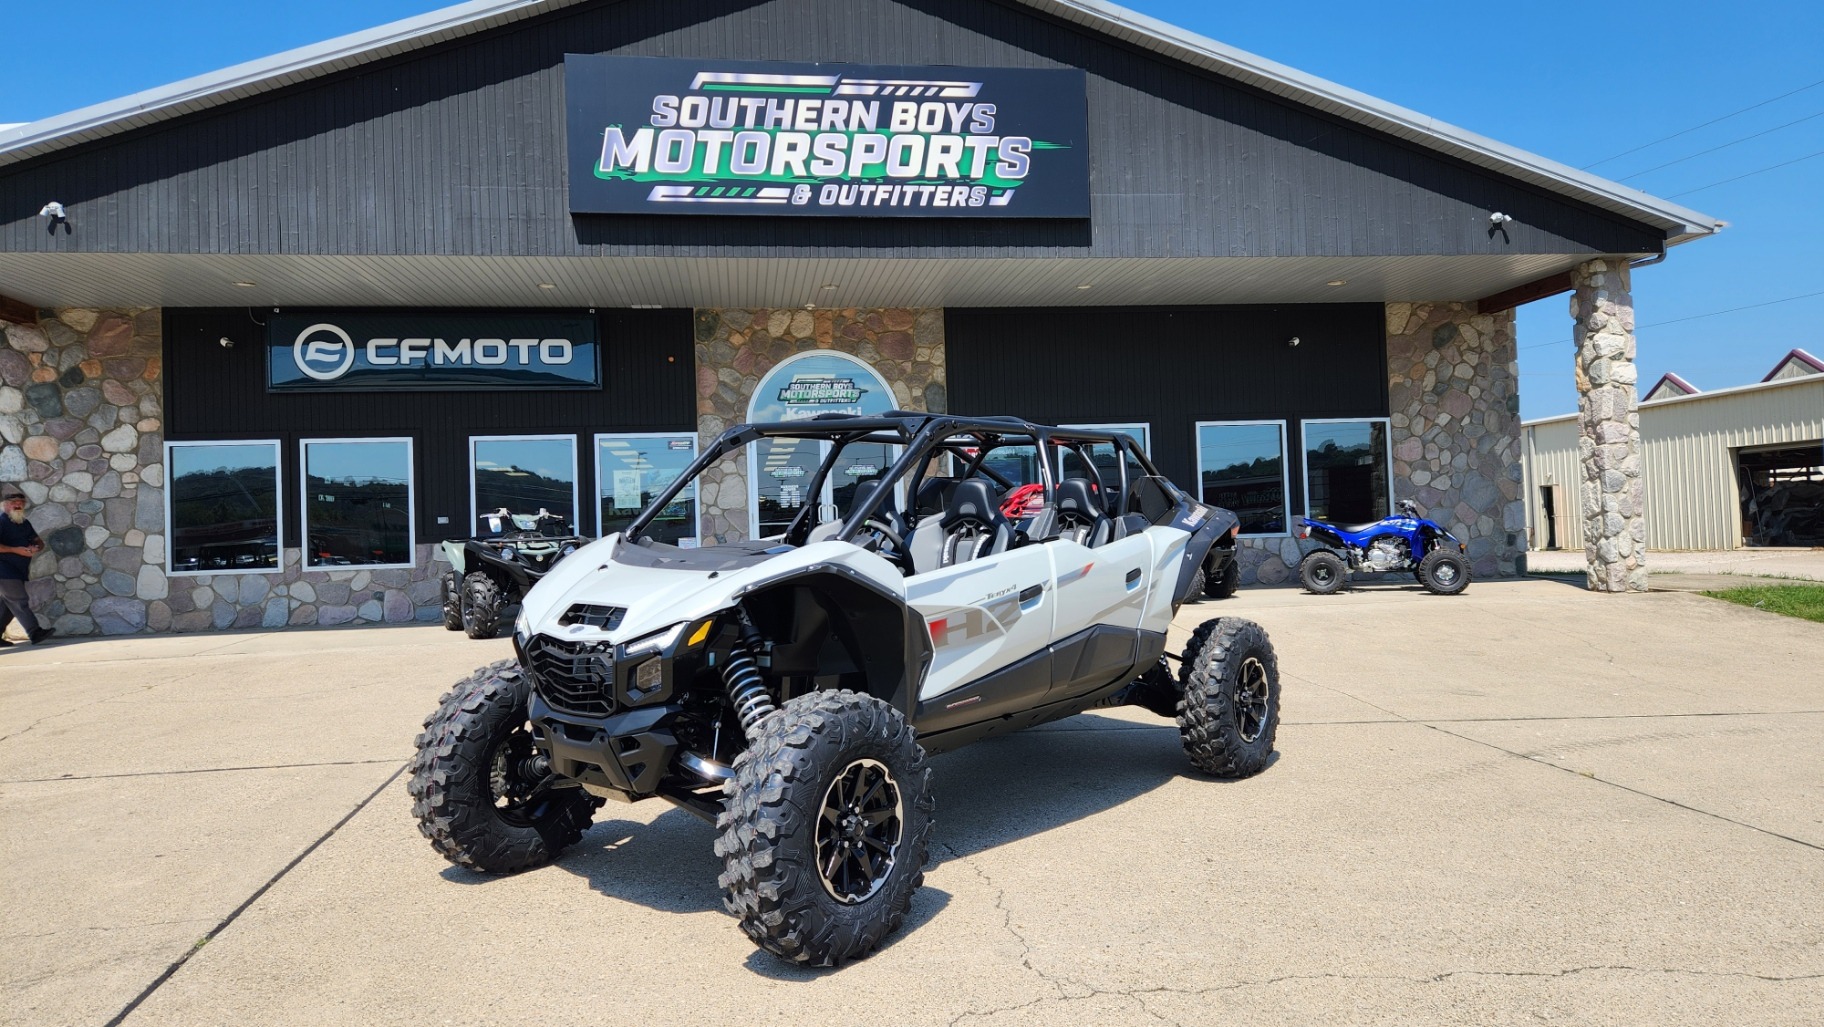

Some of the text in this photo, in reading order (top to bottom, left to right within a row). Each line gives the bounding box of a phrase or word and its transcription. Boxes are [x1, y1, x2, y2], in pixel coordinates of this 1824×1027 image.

[650, 95, 997, 133] SOUTHERN BOYS
[599, 127, 1032, 179] MOTORSPORTS
[791, 184, 987, 207] & OUTFITTERS
[366, 338, 573, 365] CFMOTO
[780, 389, 860, 399] MOTORSPORTS
